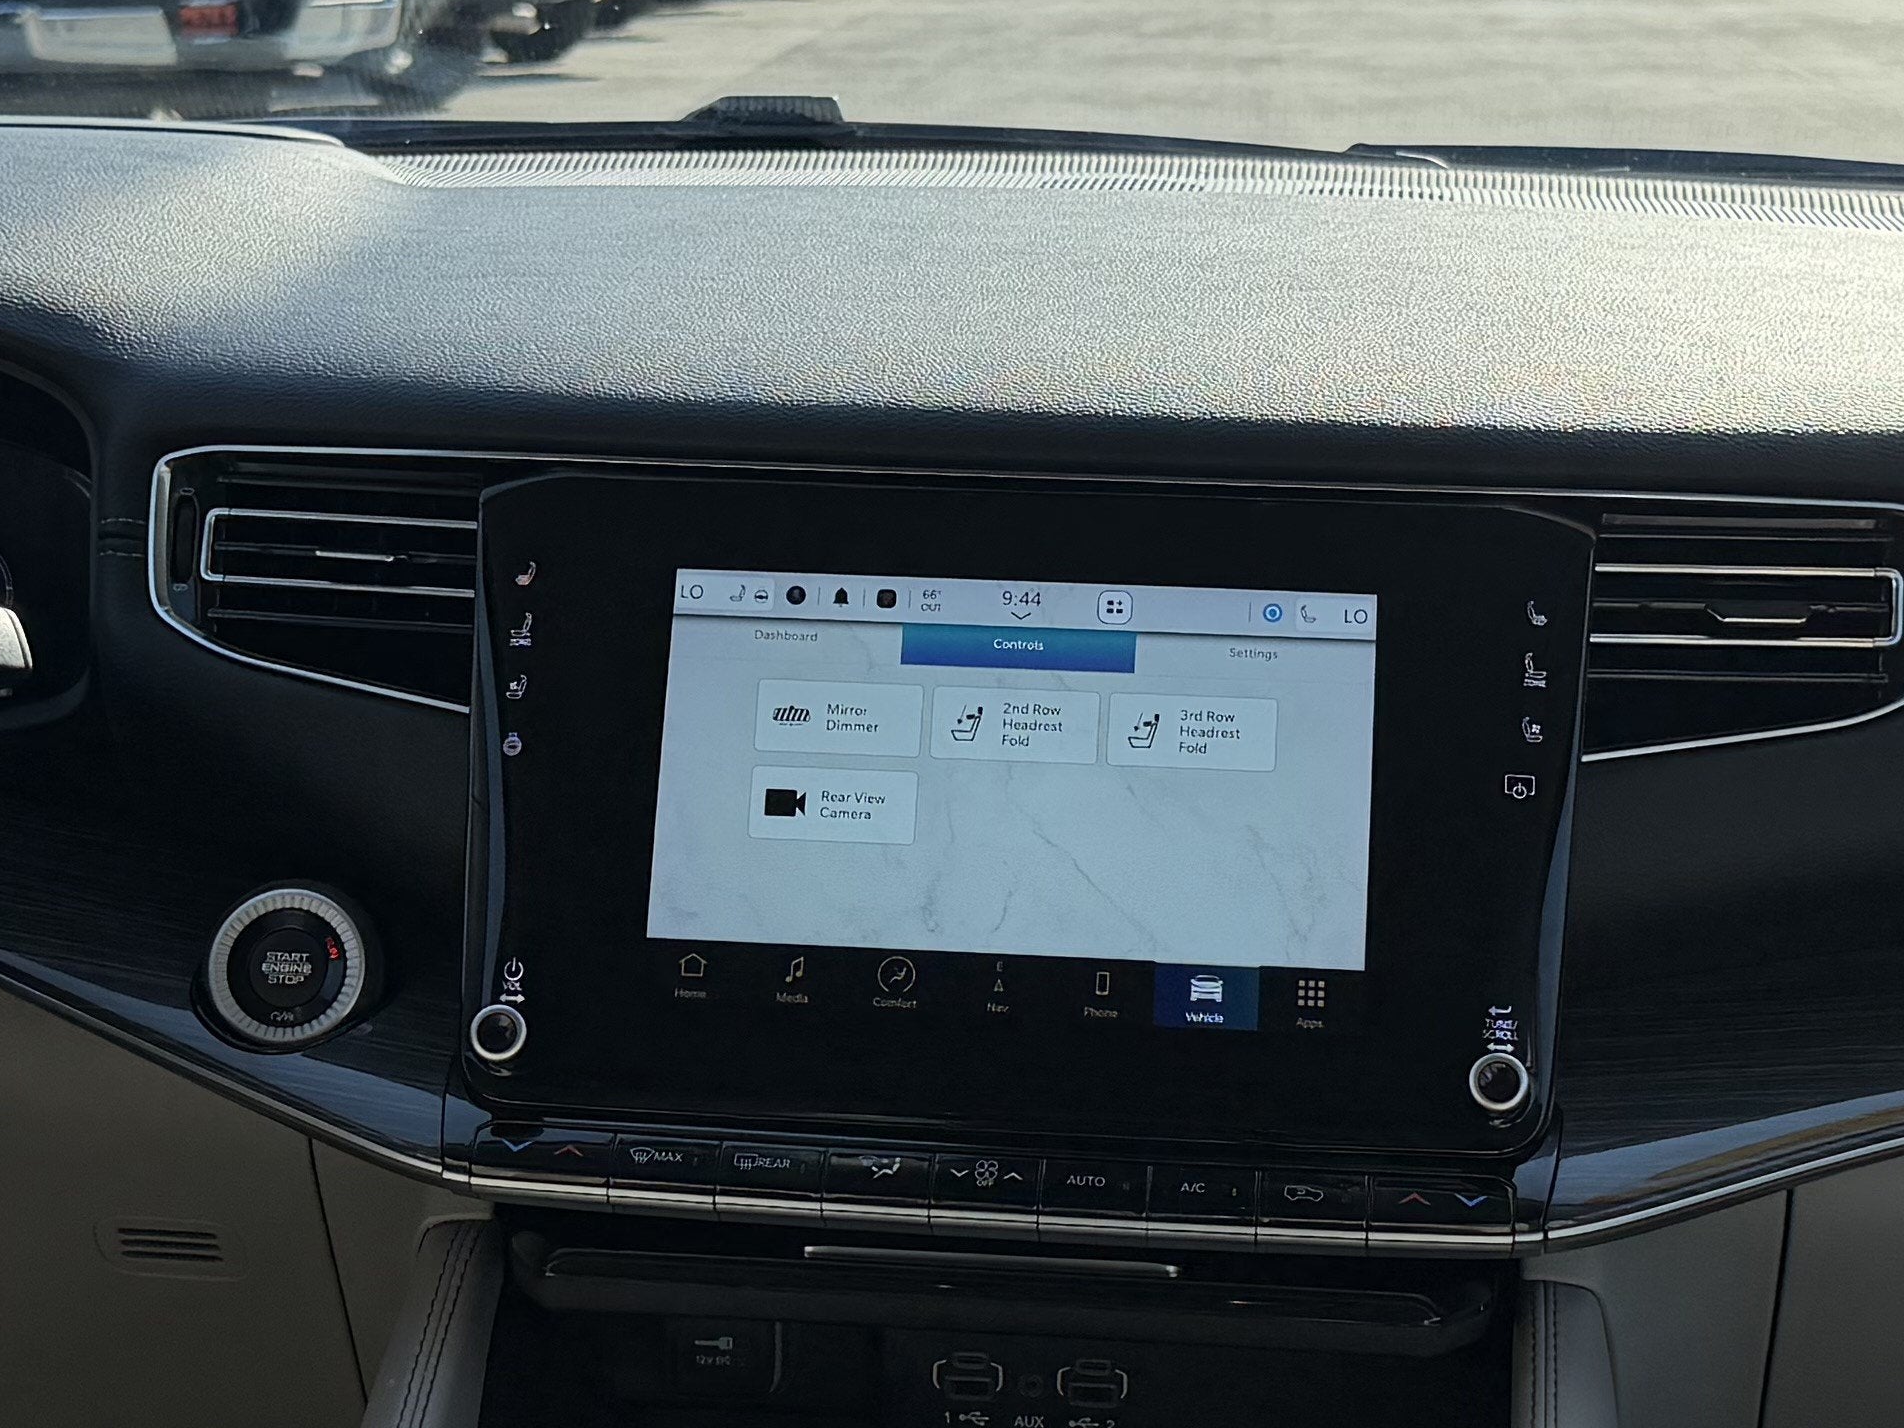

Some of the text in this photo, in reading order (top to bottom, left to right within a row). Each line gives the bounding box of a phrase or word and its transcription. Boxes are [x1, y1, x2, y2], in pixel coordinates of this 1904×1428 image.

[680, 584, 704, 600] LO
[1002, 590, 1042, 607] 9:44
[1343, 607, 1369, 625] LO
[754, 628, 819, 643] Dashboard
[993, 638, 1044, 652] Controls
[1229, 645, 1279, 663] Settings
[826, 703, 868, 717] Mirror
[1002, 702, 1061, 717] 2nd Row
[1180, 709, 1236, 725] 3rd Row
[826, 719, 879, 734] Dimmer
[1002, 718, 1063, 733] Headrest
[1001, 733, 1030, 747] Fold
[1179, 725, 1241, 741] Headrest
[1179, 741, 1208, 755] Fold
[820, 791, 886, 806] Rear View
[819, 806, 872, 821] Camera
[266, 951, 310, 962] START
[261, 962, 313, 974] ENGINE
[267, 974, 305, 985] STOP
[674, 988, 708, 1000] Home
[775, 992, 809, 1004] Media
[872, 997, 917, 1010] Comfort
[1083, 1006, 1118, 1019] Phone
[654, 1152, 683, 1163] MAX
[757, 1157, 791, 1169] REAR
[1066, 1174, 1106, 1188] AUTO
[1180, 1182, 1206, 1193] A/C
[1014, 1416, 1045, 1428] AUX
